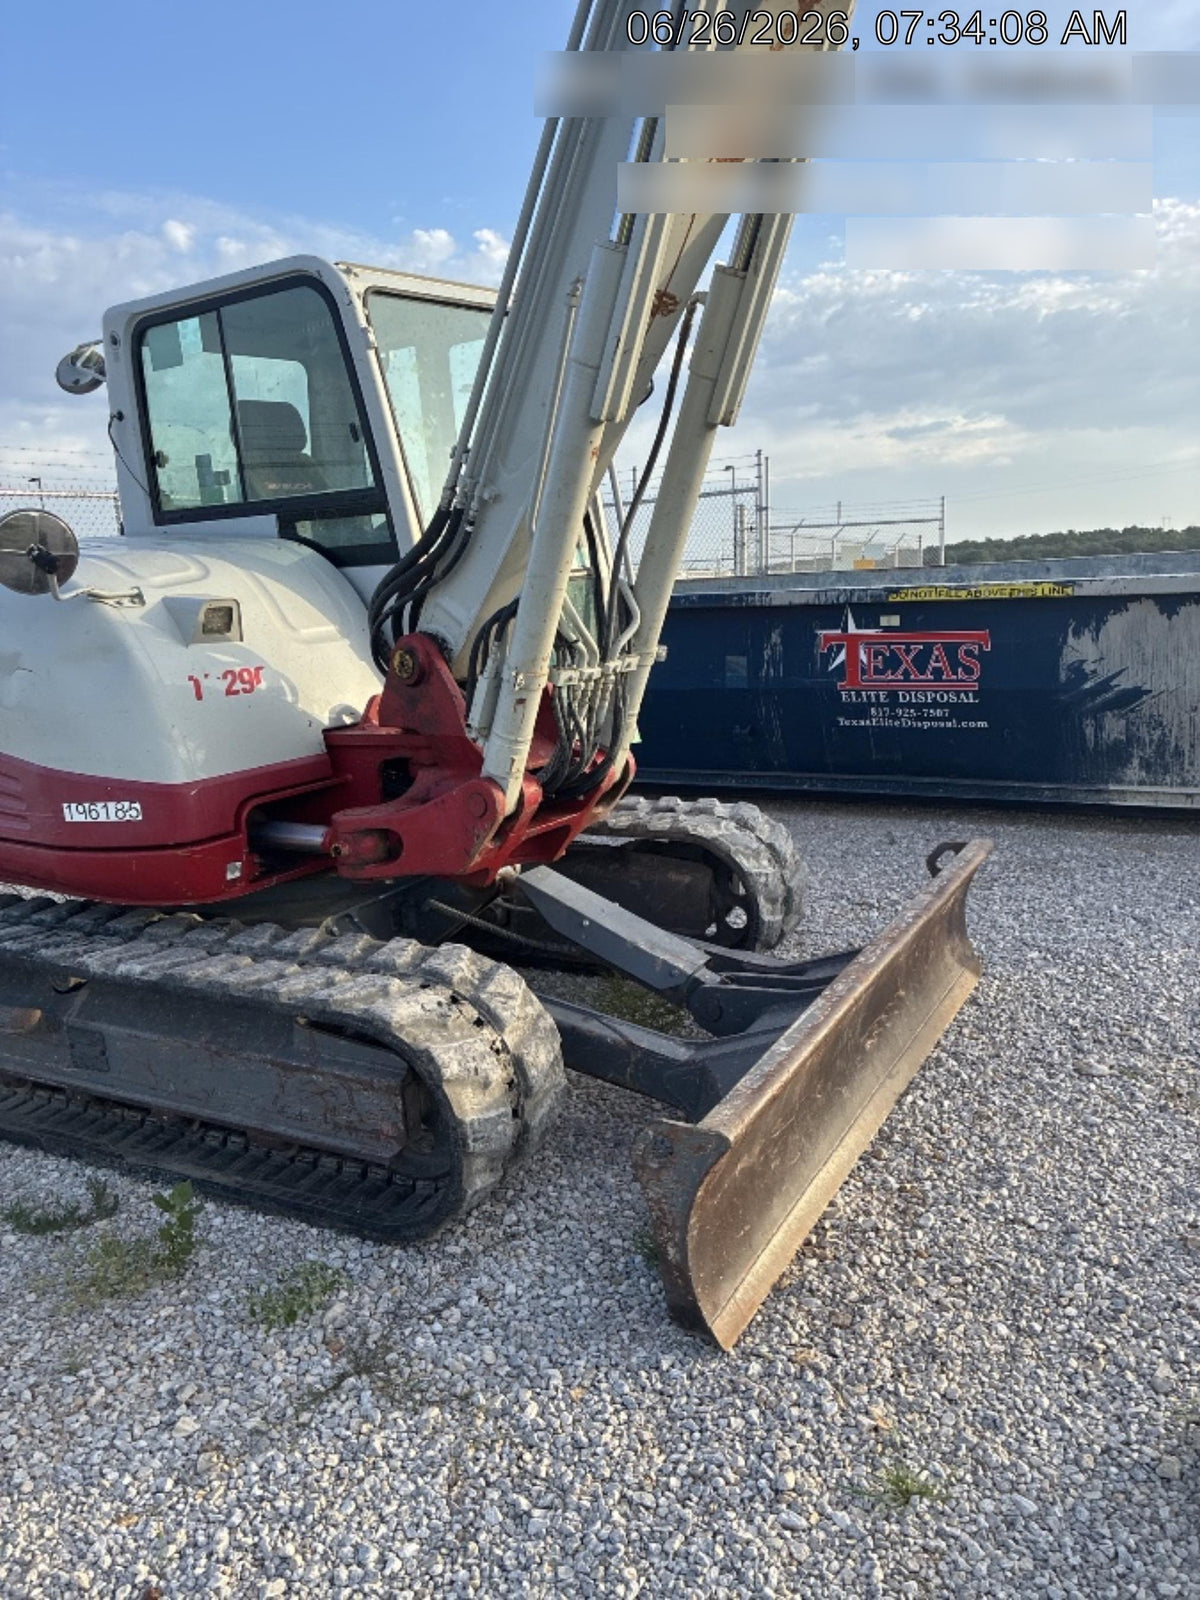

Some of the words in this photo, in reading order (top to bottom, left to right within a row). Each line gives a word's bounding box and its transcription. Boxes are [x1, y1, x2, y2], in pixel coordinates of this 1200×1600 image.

[910, 588, 934, 599] NOT
[820, 630, 991, 689] TEXAS
[840, 691, 889, 703] ELITE
[898, 691, 979, 703] DISPOSAL
[837, 717, 989, 729] TexasEliteDisposal.com
[64, 802, 140, 820] 196185
